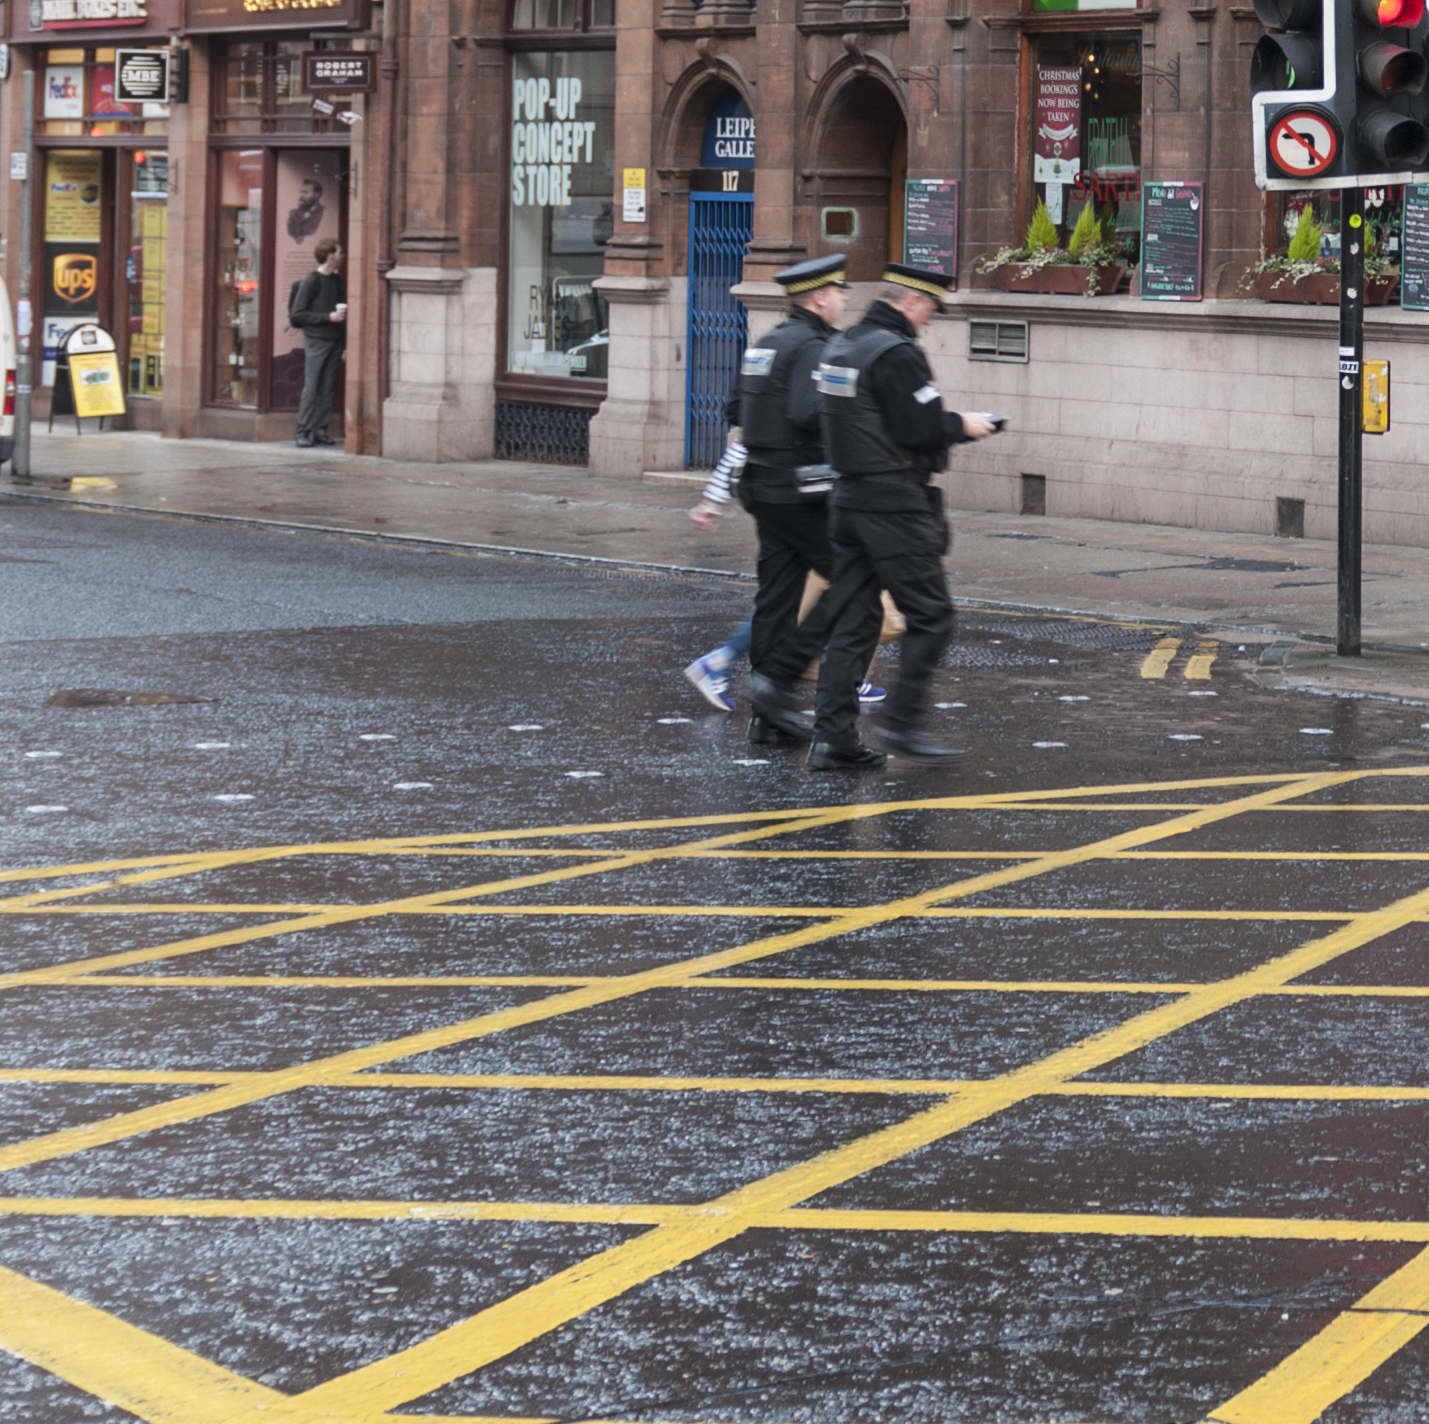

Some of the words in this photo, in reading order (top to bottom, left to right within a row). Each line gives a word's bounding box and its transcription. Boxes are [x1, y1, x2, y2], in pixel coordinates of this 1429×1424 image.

[315, 61, 363, 70] ROBERT
[315, 69, 364, 77] GRAHAM
[126, 70, 161, 83] MBE
[1039, 70, 1080, 82] CHRISTMAS
[50, 76, 78, 99] FedEx
[1040, 84, 1078, 95] BOOKINGS
[513, 77, 582, 121] POP-UP
[1038, 98, 1056, 108] NOW
[1057, 98, 1080, 109] BEING
[1047, 112, 1070, 122] TAKEN
[512, 121, 596, 164] CONCEPT
[512, 164, 572, 207] STORE
[722, 170, 739, 192] 117
[1072, 172, 1141, 202] SARTI
[56, 267, 93, 295] ups
